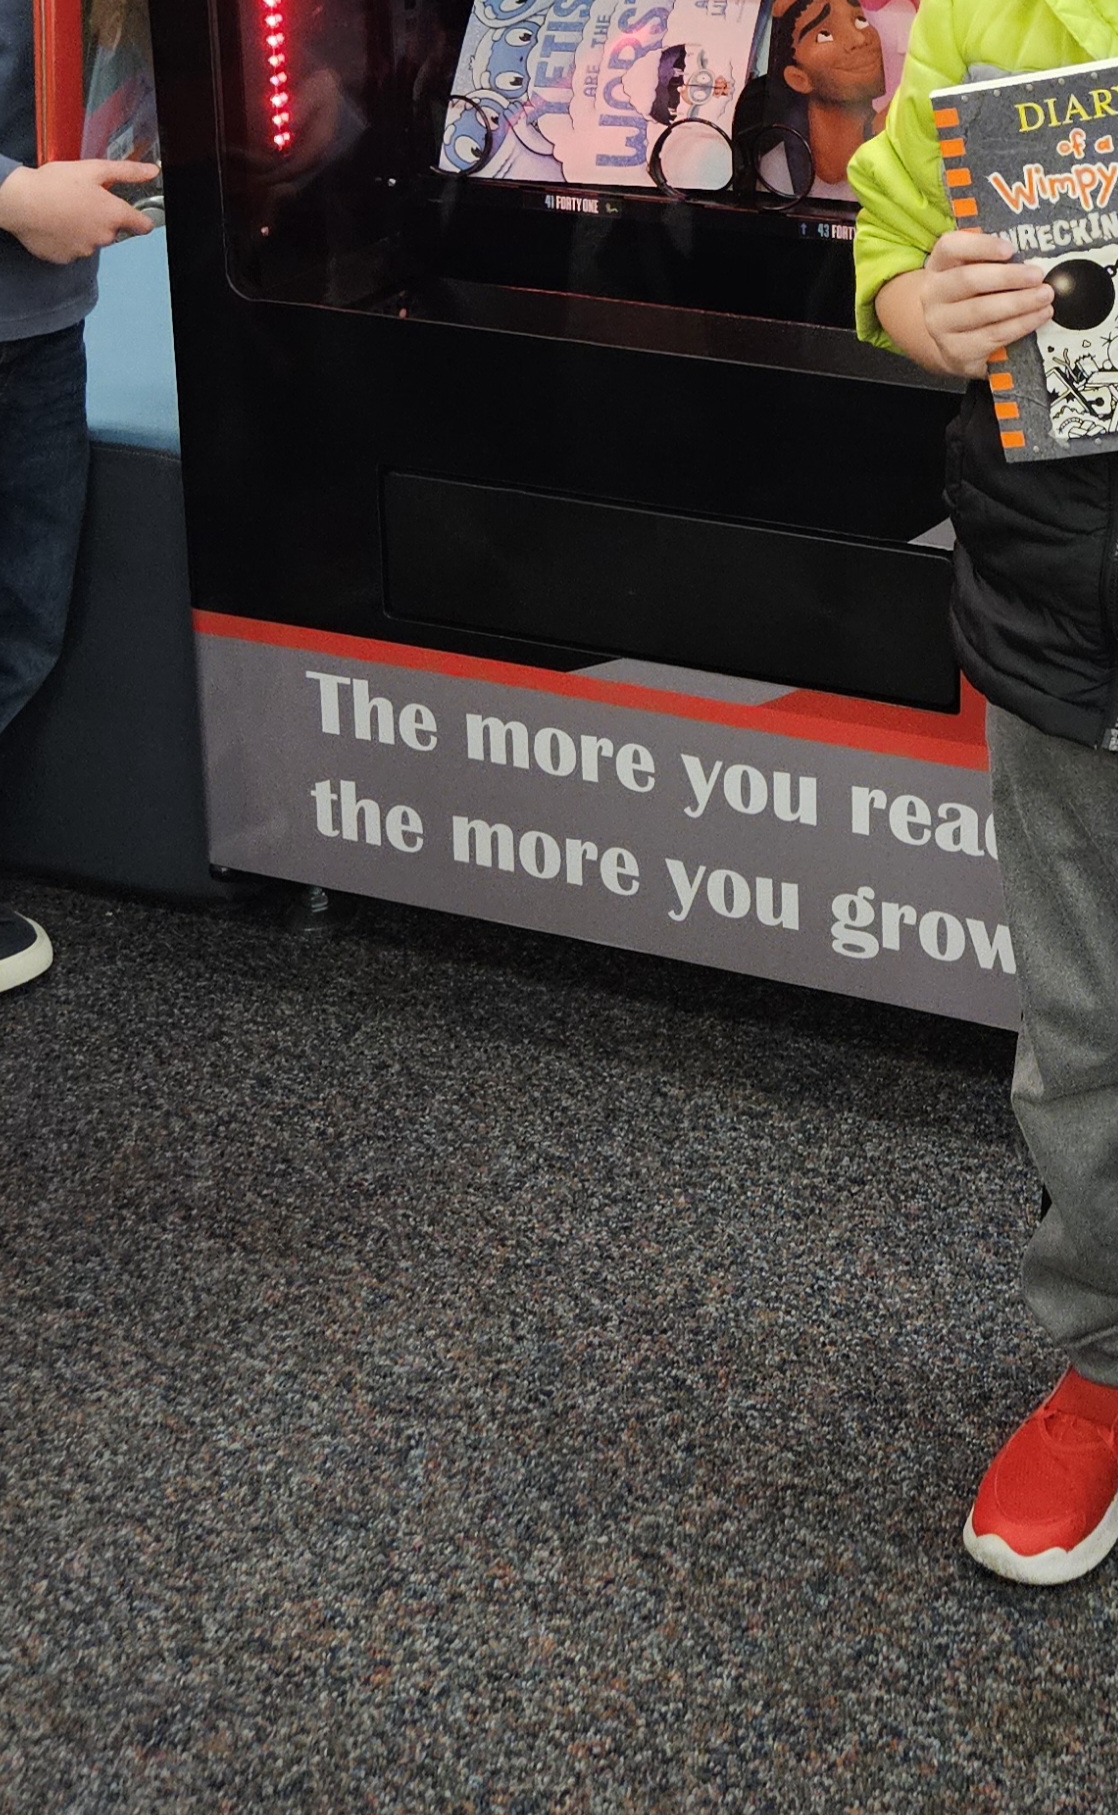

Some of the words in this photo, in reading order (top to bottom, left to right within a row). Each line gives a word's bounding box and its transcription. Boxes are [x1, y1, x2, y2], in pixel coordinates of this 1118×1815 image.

[591, 13, 611, 48] THE
[584, 64, 600, 98] ARE
[1056, 128, 1087, 158] of
[1096, 134, 1114, 154] a
[989, 153, 1118, 214] Wimpy
[545, 194, 554, 209] 41
[556, 195, 582, 212] FORTY
[583, 198, 599, 214] ONE
[818, 223, 830, 238] 43
[305, 671, 438, 751] The
[466, 712, 656, 792] more
[681, 753, 818, 826] you
[311, 780, 424, 853] the
[453, 814, 640, 896] more
[665, 857, 799, 931] you
[831, 886, 1017, 975] grow
